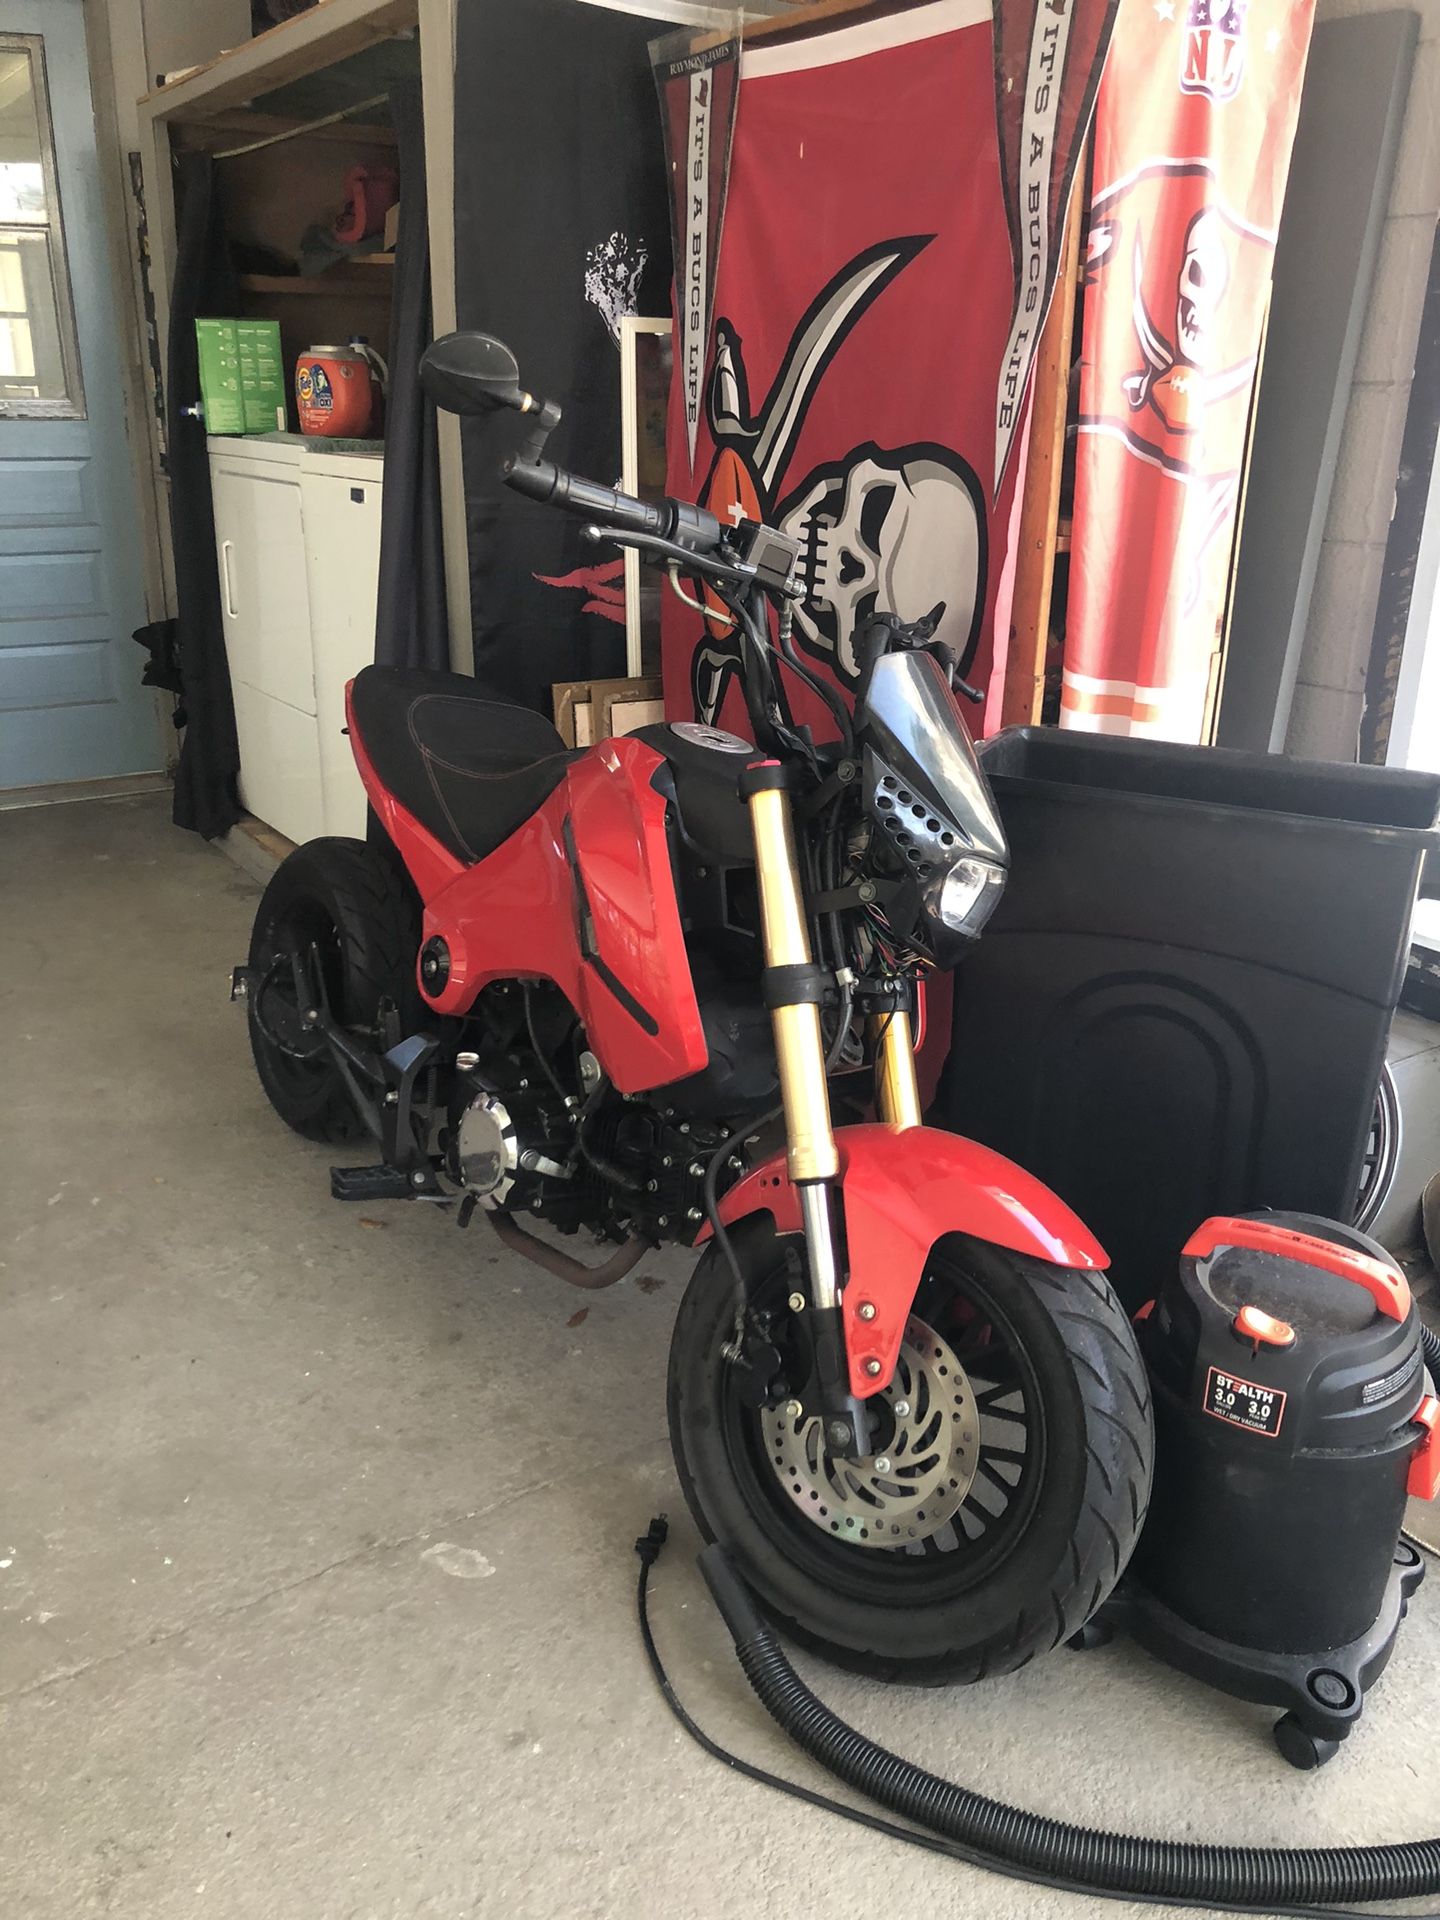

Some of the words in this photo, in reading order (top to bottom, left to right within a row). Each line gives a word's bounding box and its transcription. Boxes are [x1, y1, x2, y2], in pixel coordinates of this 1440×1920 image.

[670, 54, 707, 75] RAYMOND
[707, 47, 729, 62] JAMES
[1034, 24, 1059, 114] IT'S
[693, 113, 704, 182] IT'S
[1029, 133, 1044, 167] A
[693, 195, 702, 220] A
[1024, 181, 1041, 313] BUCS
[690, 232, 701, 332] BUCS
[688, 345, 698, 423] LIFE
[998, 329, 1029, 429] LIFE
[1215, 1388, 1235, 1405] 3.0
[1217, 1375, 1274, 1404] STEALTH
[1214, 1406, 1226, 1415] WET
[1229, 1413, 1241, 1421] DRY
[1241, 1416, 1267, 1430] VACUUM
[1248, 1401, 1271, 1418] 3.0
